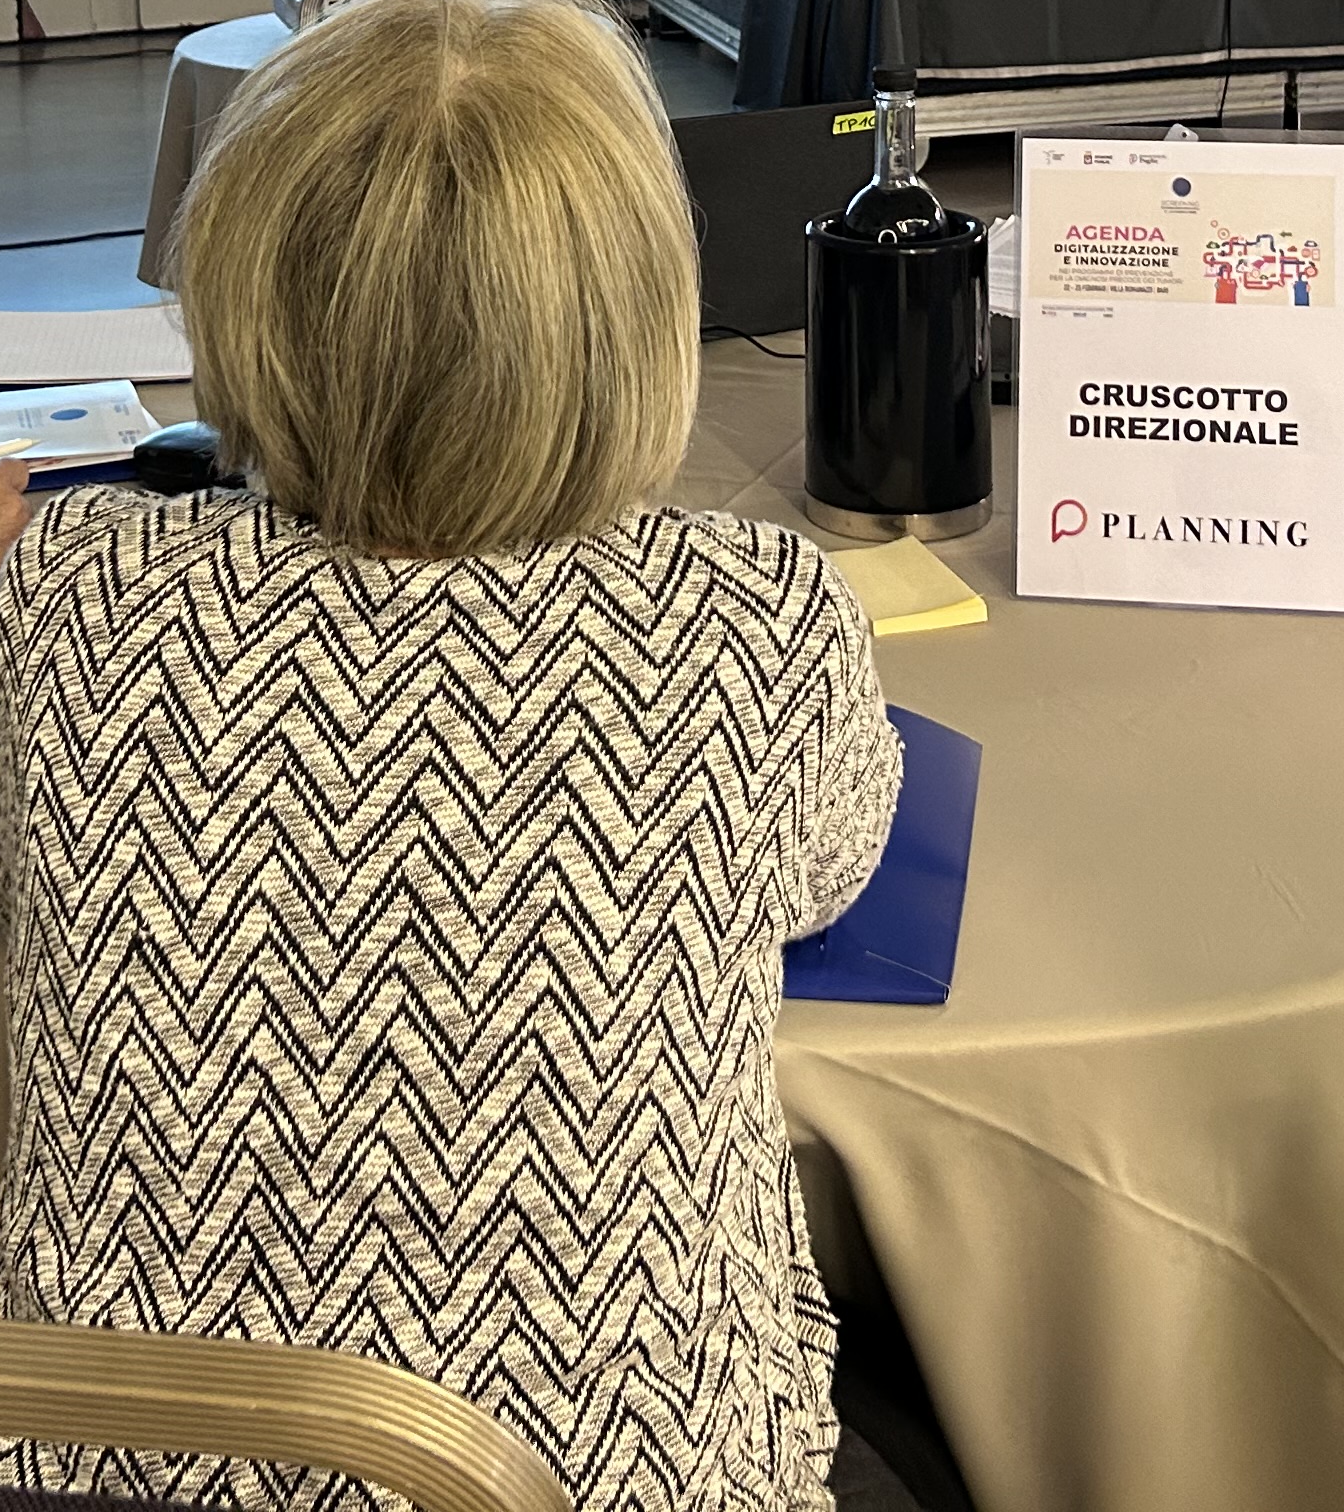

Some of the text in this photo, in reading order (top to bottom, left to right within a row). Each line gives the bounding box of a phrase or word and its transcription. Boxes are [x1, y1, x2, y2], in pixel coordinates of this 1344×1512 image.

[1065, 224, 1165, 242] AGENDA
[1054, 244, 1179, 256] DIGITALIZZAZIONE
[1063, 256, 1169, 268] E INNOVAZIONE
[1079, 382, 1289, 413] CRUSCOTTO
[1069, 414, 1300, 446] DIREZIONALE
[1102, 512, 1310, 548] PLANNING
